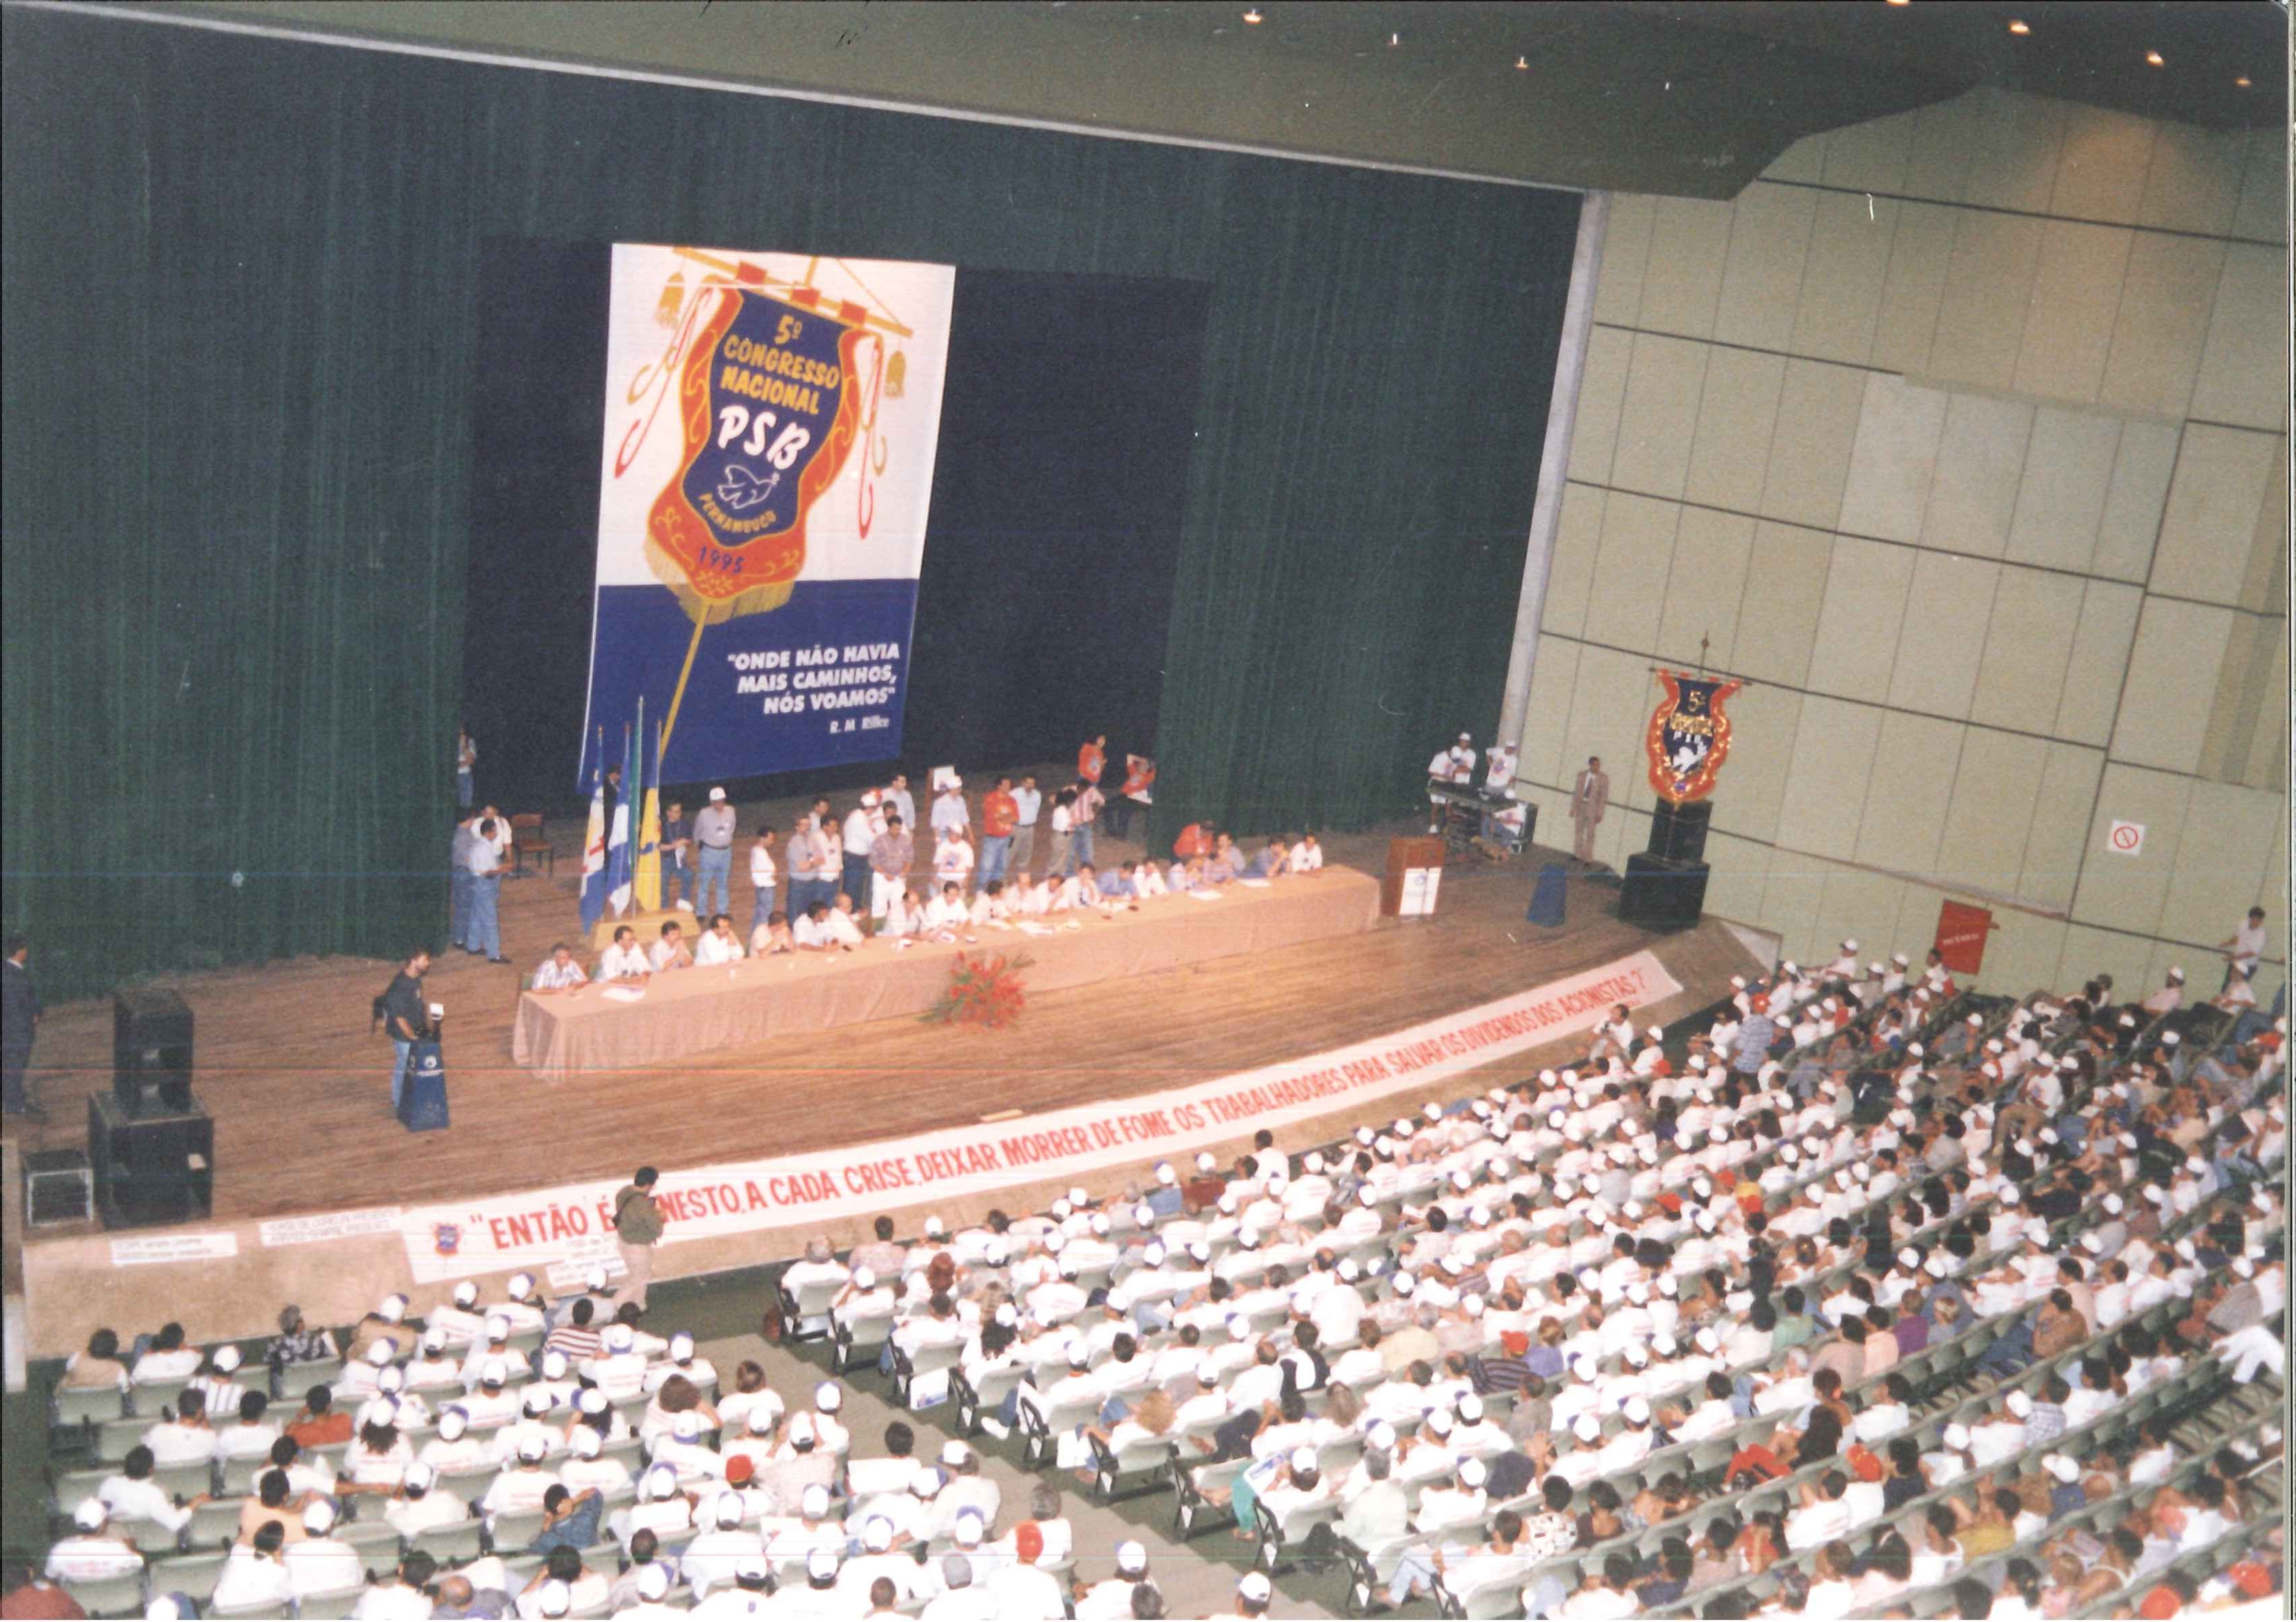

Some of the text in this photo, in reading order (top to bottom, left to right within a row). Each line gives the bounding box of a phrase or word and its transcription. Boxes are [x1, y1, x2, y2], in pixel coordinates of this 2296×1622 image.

[724, 334, 839, 389] CONGRESSO
[720, 365, 820, 415] NACIONAL
[717, 406, 810, 470] PSB
[699, 493, 776, 533] PERNAMBUCO
[700, 545, 745, 573] 1995
[728, 643, 900, 670] "ONDE NÃO HAVIA
[737, 664, 897, 694] MAIS CAMINHOS,
[764, 687, 895, 714] NÓS VOAMOS"
[470, 1203, 589, 1251] "ENTÃO
[596, 1195, 617, 1232] É
[745, 1180, 769, 1211] A
[769, 1170, 841, 1206] CADA
[843, 1158, 922, 1195] CRISE,
[914, 1143, 1002, 1182] DEIXAR
[999, 1126, 1094, 1167] MORRER
[1089, 1122, 1123, 1149] DE
[1117, 1110, 1177, 1143] FOME
[1173, 1103, 1205, 1131] OS
[1200, 1068, 1348, 1124] TRABALHADORES
[1341, 1056, 1391, 1087] PARA
[1385, 1039, 1449, 1074] SALVAR
[1440, 1032, 1466, 1056] OS
[1458, 1010, 1538, 1050] DIVIDENDOS
[1530, 1001, 1563, 1026] DOS
[1557, 975, 1637, 1016] ACIONISTAS
